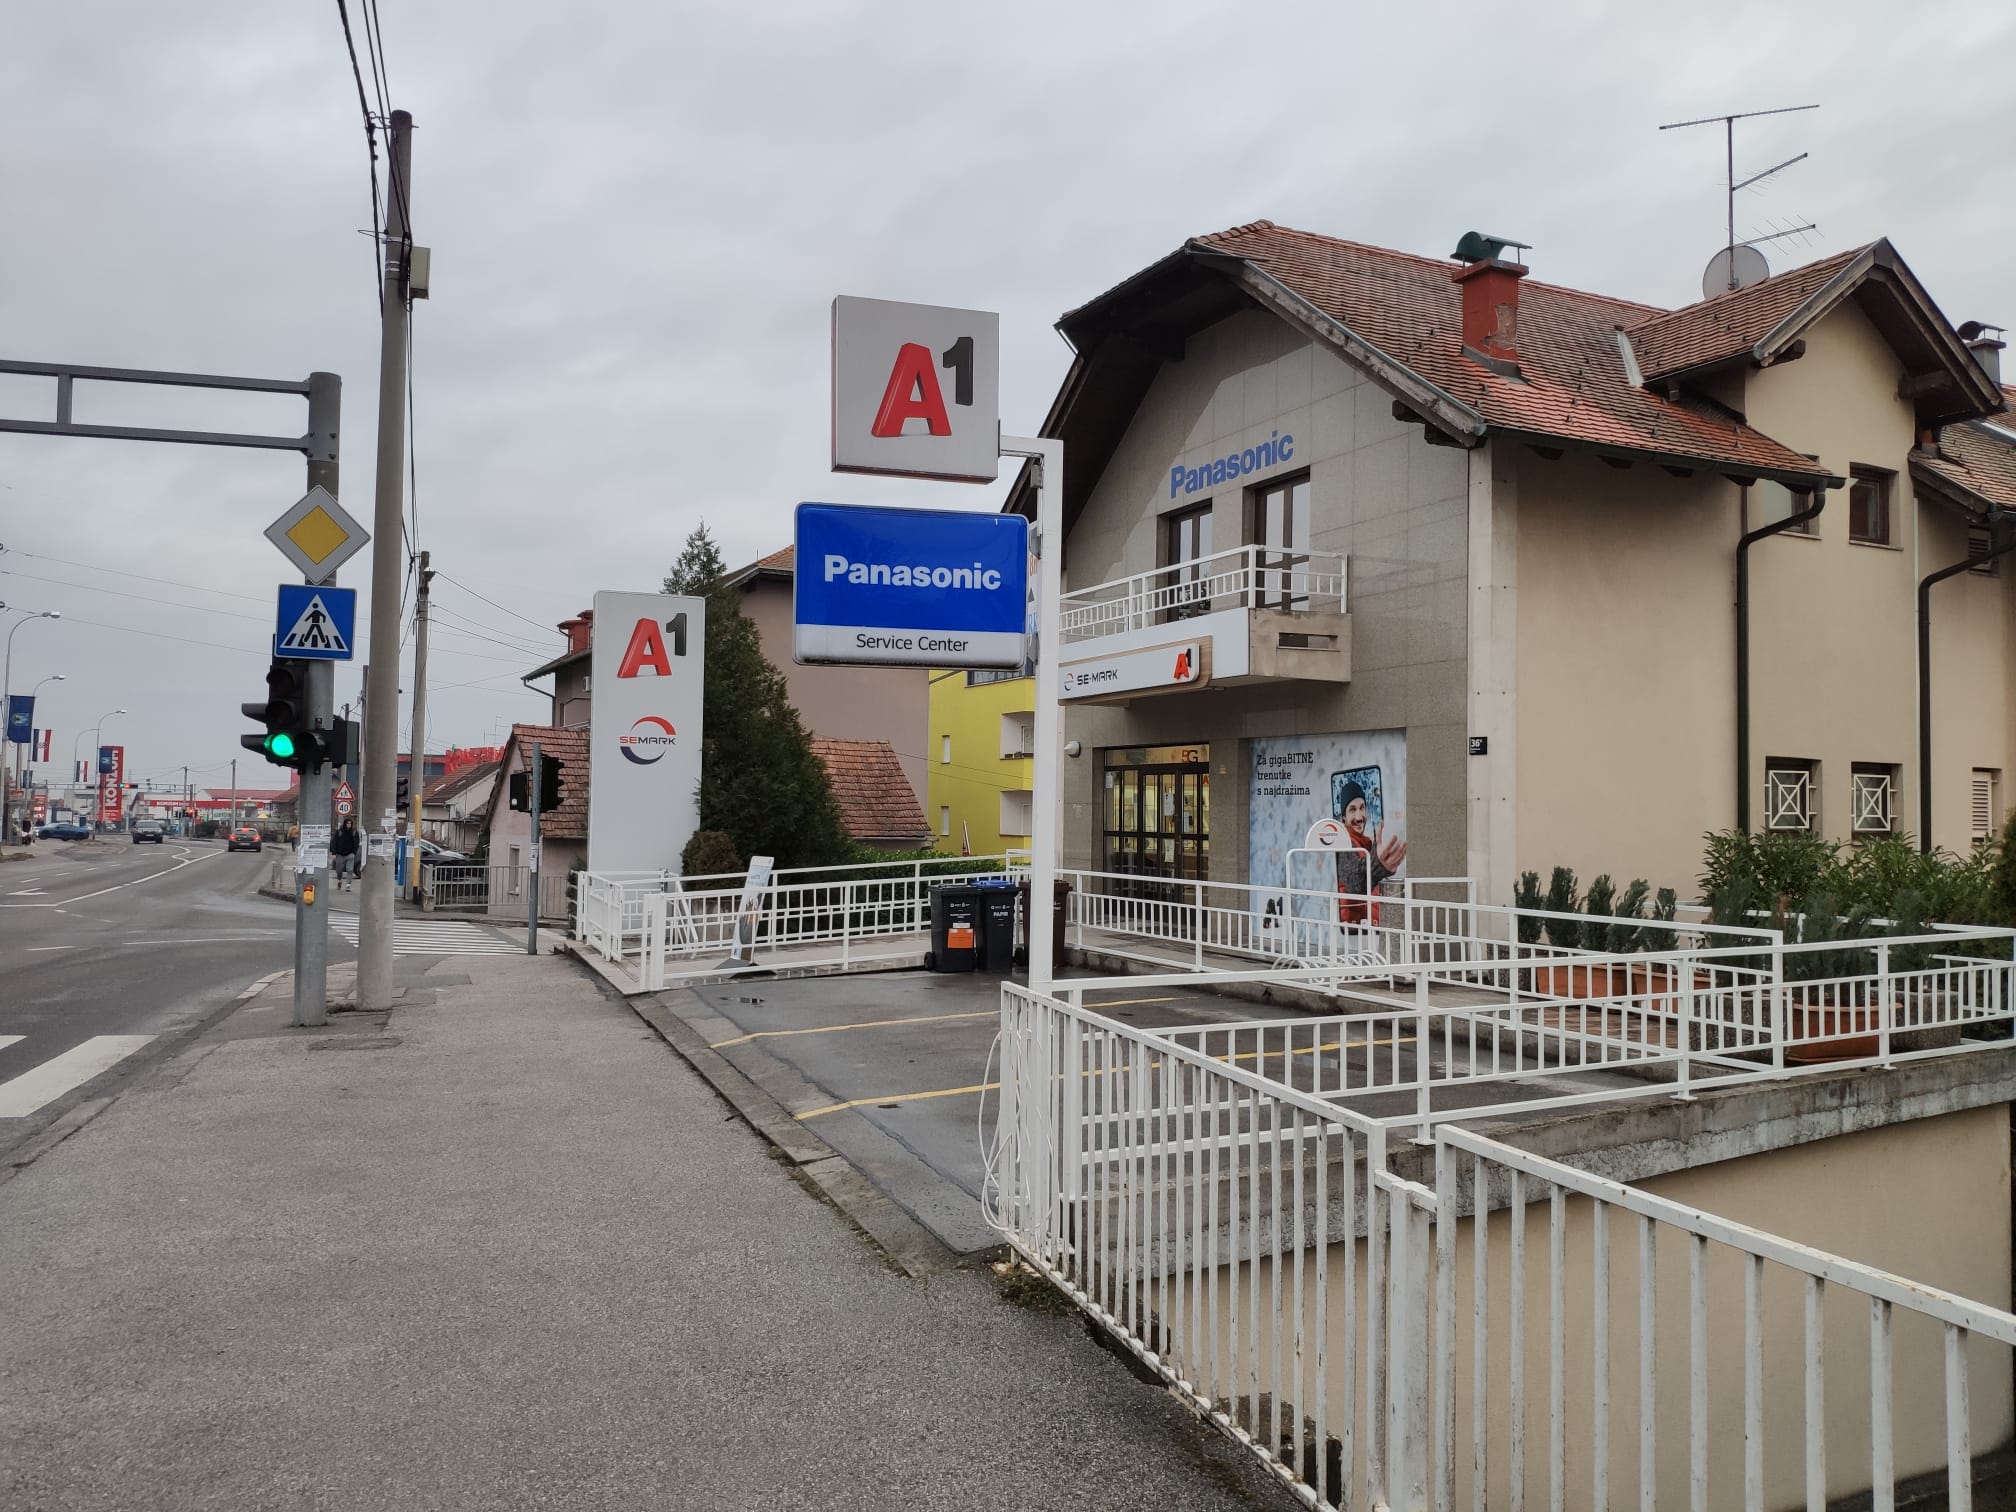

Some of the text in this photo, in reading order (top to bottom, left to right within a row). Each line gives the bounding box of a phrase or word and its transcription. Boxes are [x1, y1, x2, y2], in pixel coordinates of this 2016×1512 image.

[871, 336, 974, 438] A1
[1171, 430, 1294, 499] Panasonic
[824, 554, 1001, 591] Panasonic
[617, 612, 687, 679] A1
[856, 633, 969, 653] Service Center
[1076, 648, 1192, 686] SE-MARK A1
[619, 736, 676, 745] SEMARK
[1256, 752, 1314, 767] Za gigaBITNE
[1257, 769, 1292, 780] trenutke
[1257, 785, 1310, 798] s najdražima
[339, 803, 348, 812] 40
